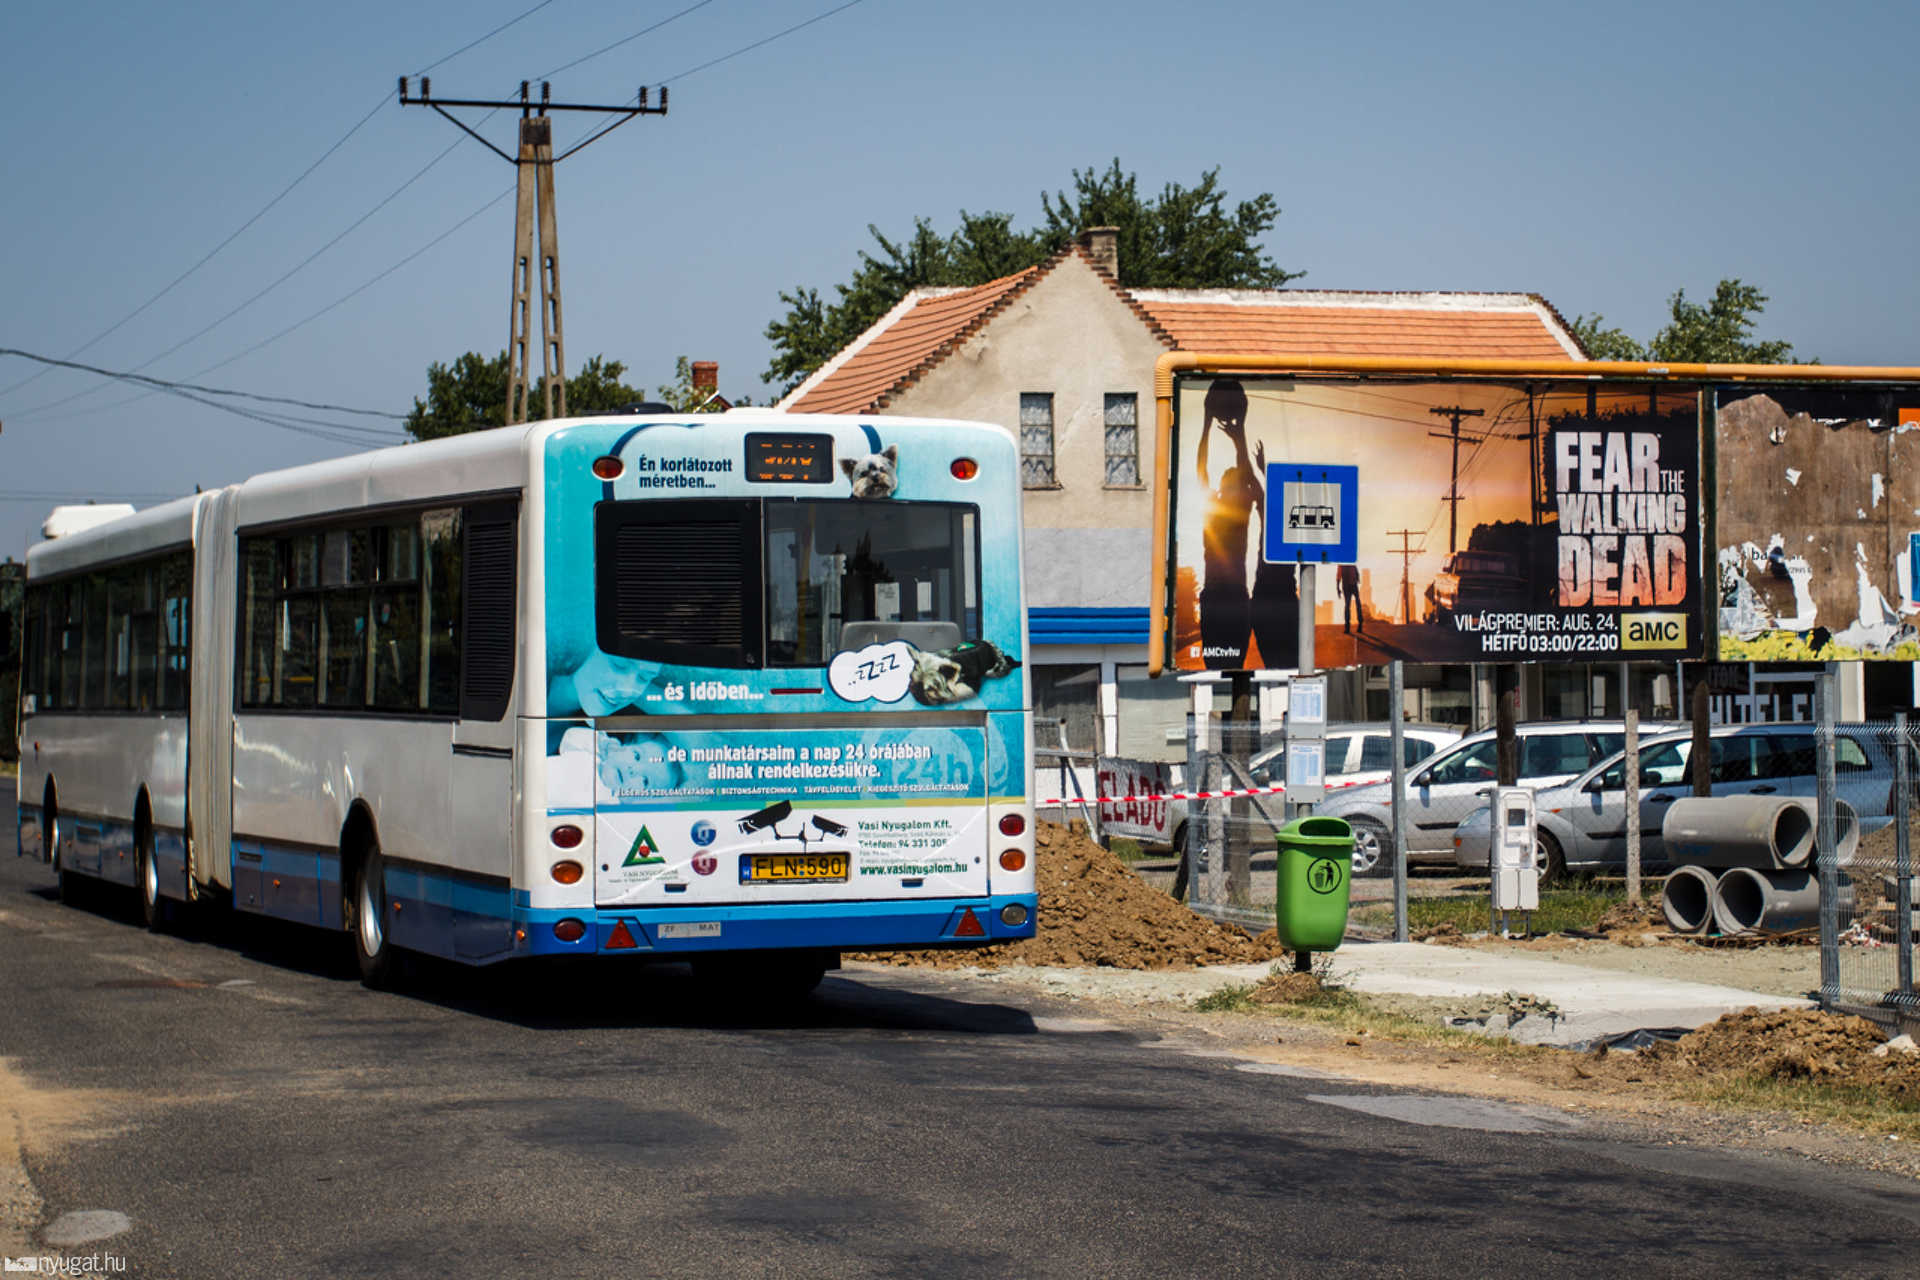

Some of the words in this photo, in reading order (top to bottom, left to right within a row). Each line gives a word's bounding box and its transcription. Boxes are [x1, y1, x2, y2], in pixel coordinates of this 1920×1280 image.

[639, 453, 656, 472] Én
[660, 456, 733, 472] korlátozott
[1556, 431, 1660, 493] FEAR
[1660, 470, 1685, 493] THE
[1557, 493, 1687, 534] WALKING
[1558, 535, 1687, 607] DEAD
[1454, 610, 1560, 632] VILÁGPREMIER:
[1562, 615, 1593, 631] AUG.
[1597, 613, 1619, 631] 24.
[1482, 631, 1528, 651] HÉTFŐ
[1529, 634, 1619, 652] 03:00/22:00
[691, 745, 795, 762] munkatársaim
[799, 748, 809, 761] a
[814, 745, 841, 763] nap
[845, 744, 865, 759] 24
[869, 743, 932, 762] órájában
[708, 762, 753, 779] állnak
[757, 761, 881, 778] rendelkezésükre.
[1099, 765, 1167, 832] ELADÓ
[858, 821, 879, 830] Vasi
[881, 821, 931, 831] Nyugalom
[933, 819, 952, 829] Kft.
[860, 862, 968, 875] www.vasinyugalom.hu
